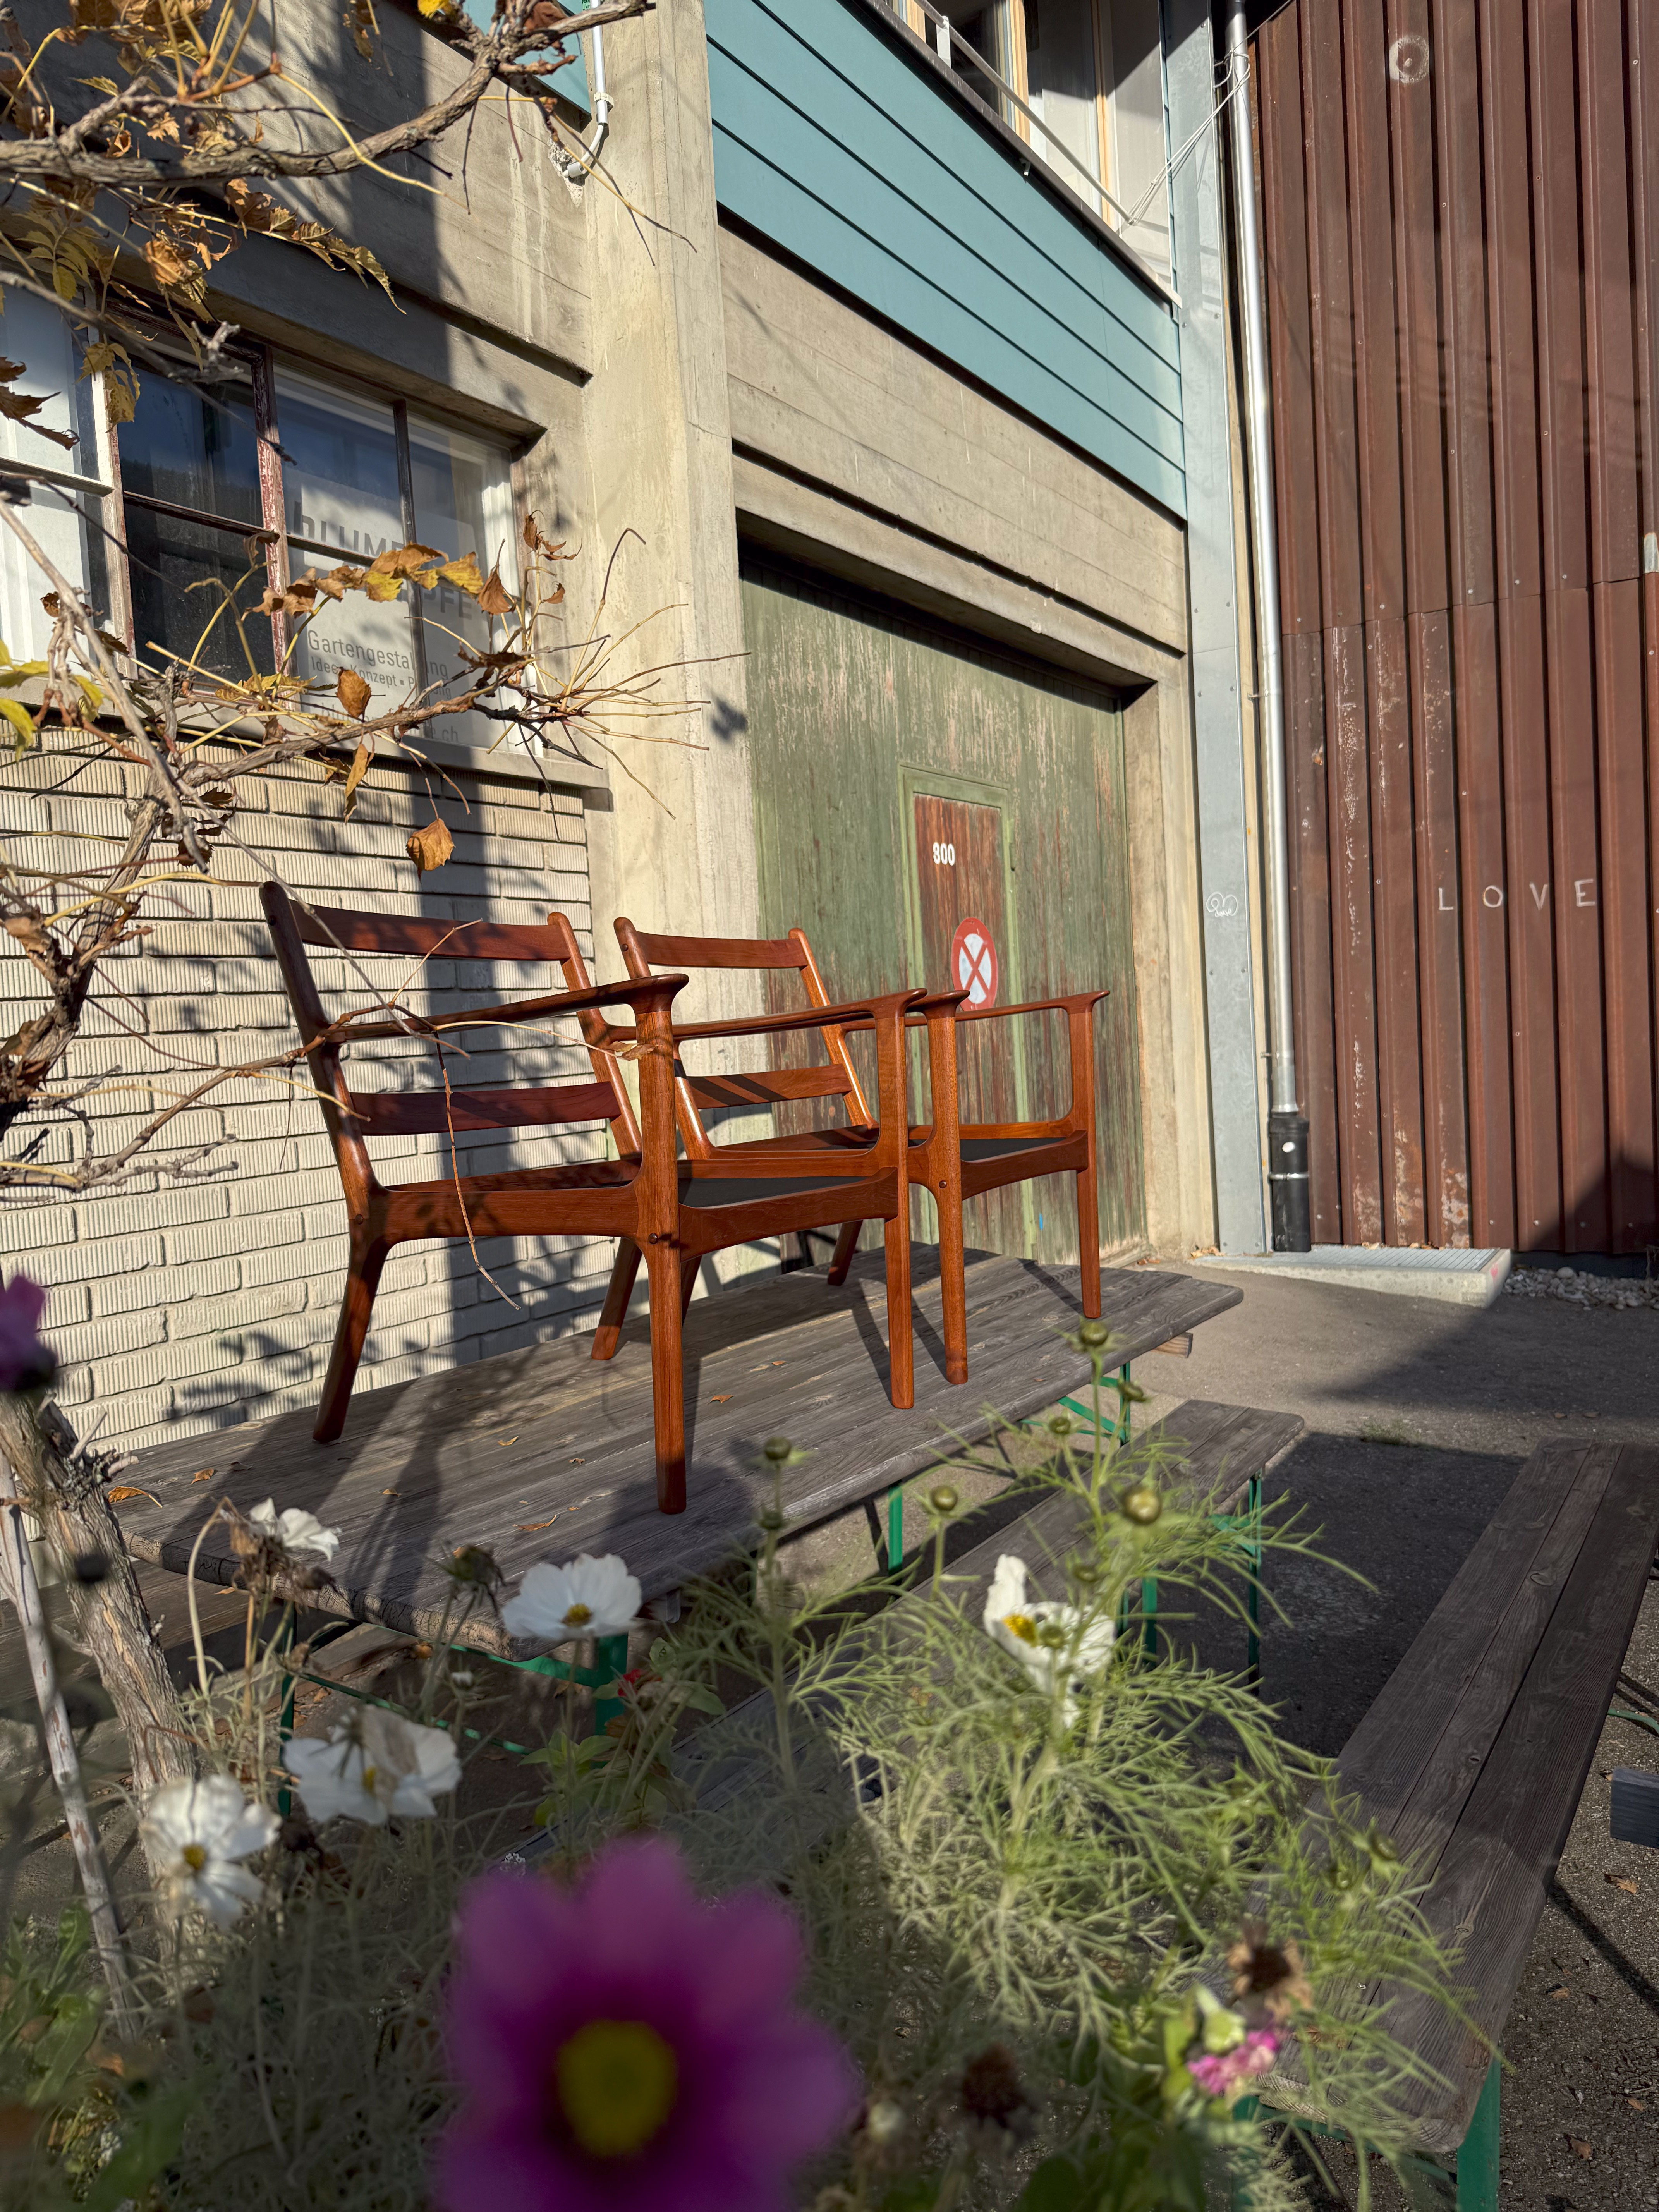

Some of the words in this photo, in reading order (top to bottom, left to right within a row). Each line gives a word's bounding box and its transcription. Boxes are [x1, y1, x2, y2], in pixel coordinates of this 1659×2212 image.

[308, 630, 448, 680] Gartengestalng
[933, 842, 956, 866] 800
[1438, 879, 1595, 910] LOVE
